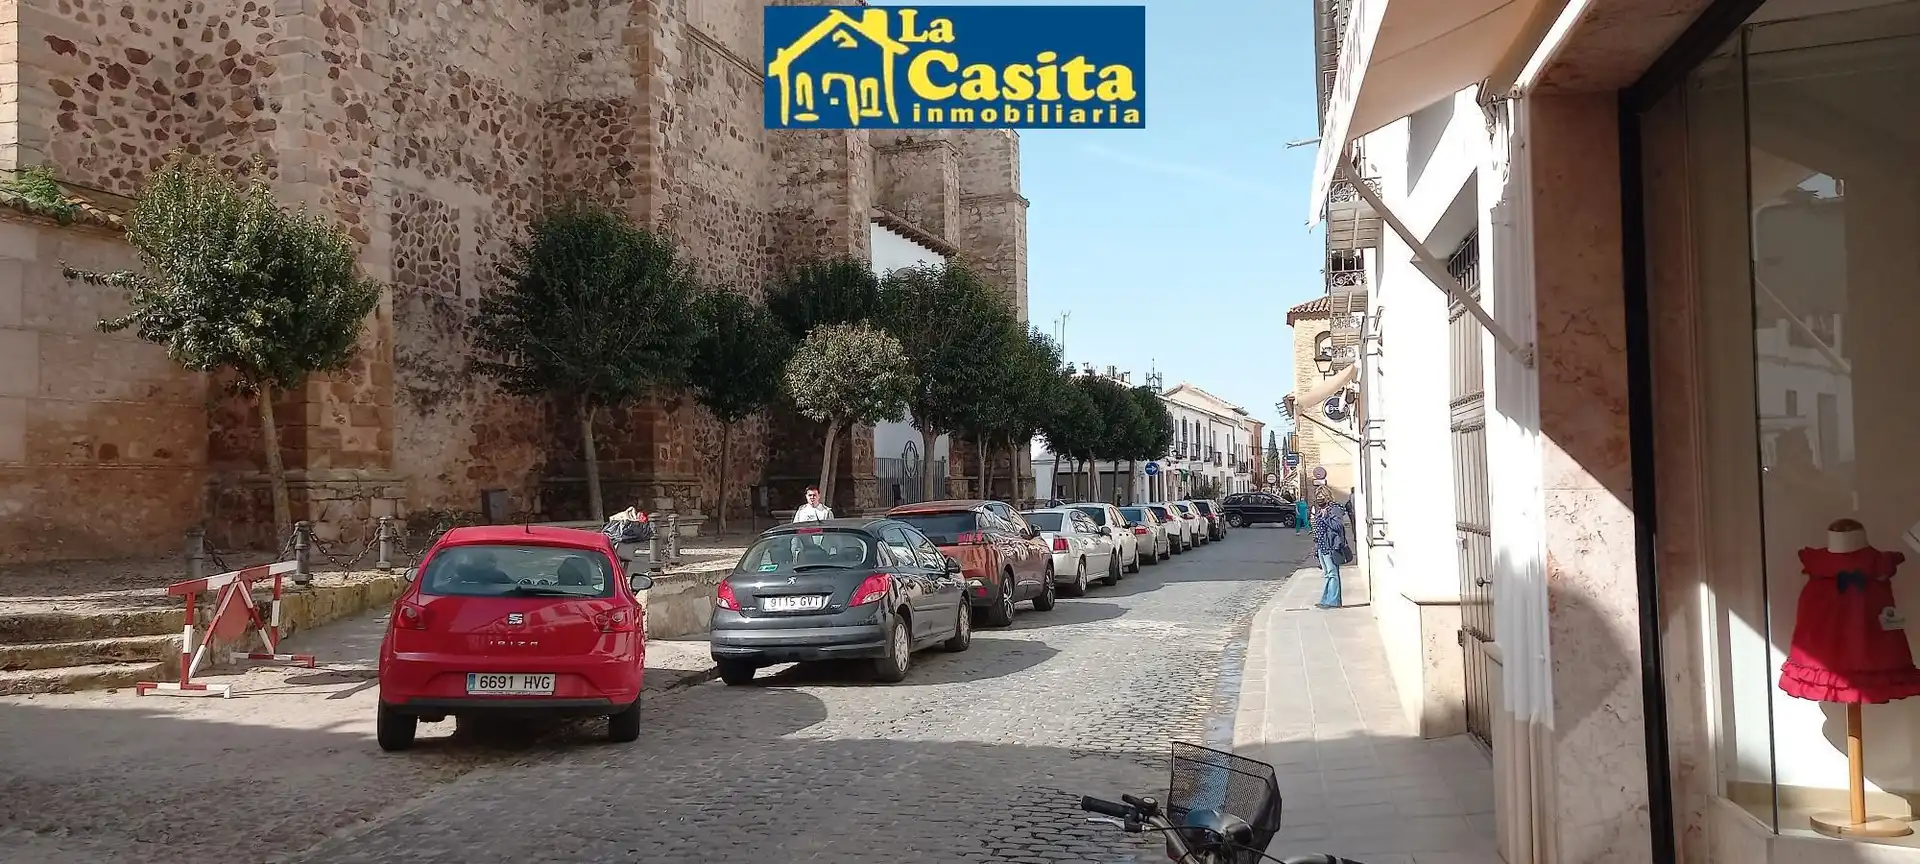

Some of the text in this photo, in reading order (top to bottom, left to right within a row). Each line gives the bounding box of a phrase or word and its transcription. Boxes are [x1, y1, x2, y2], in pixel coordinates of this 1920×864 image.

[800, 596, 819, 607] GVT
[480, 675, 550, 690] 6691 HVG
